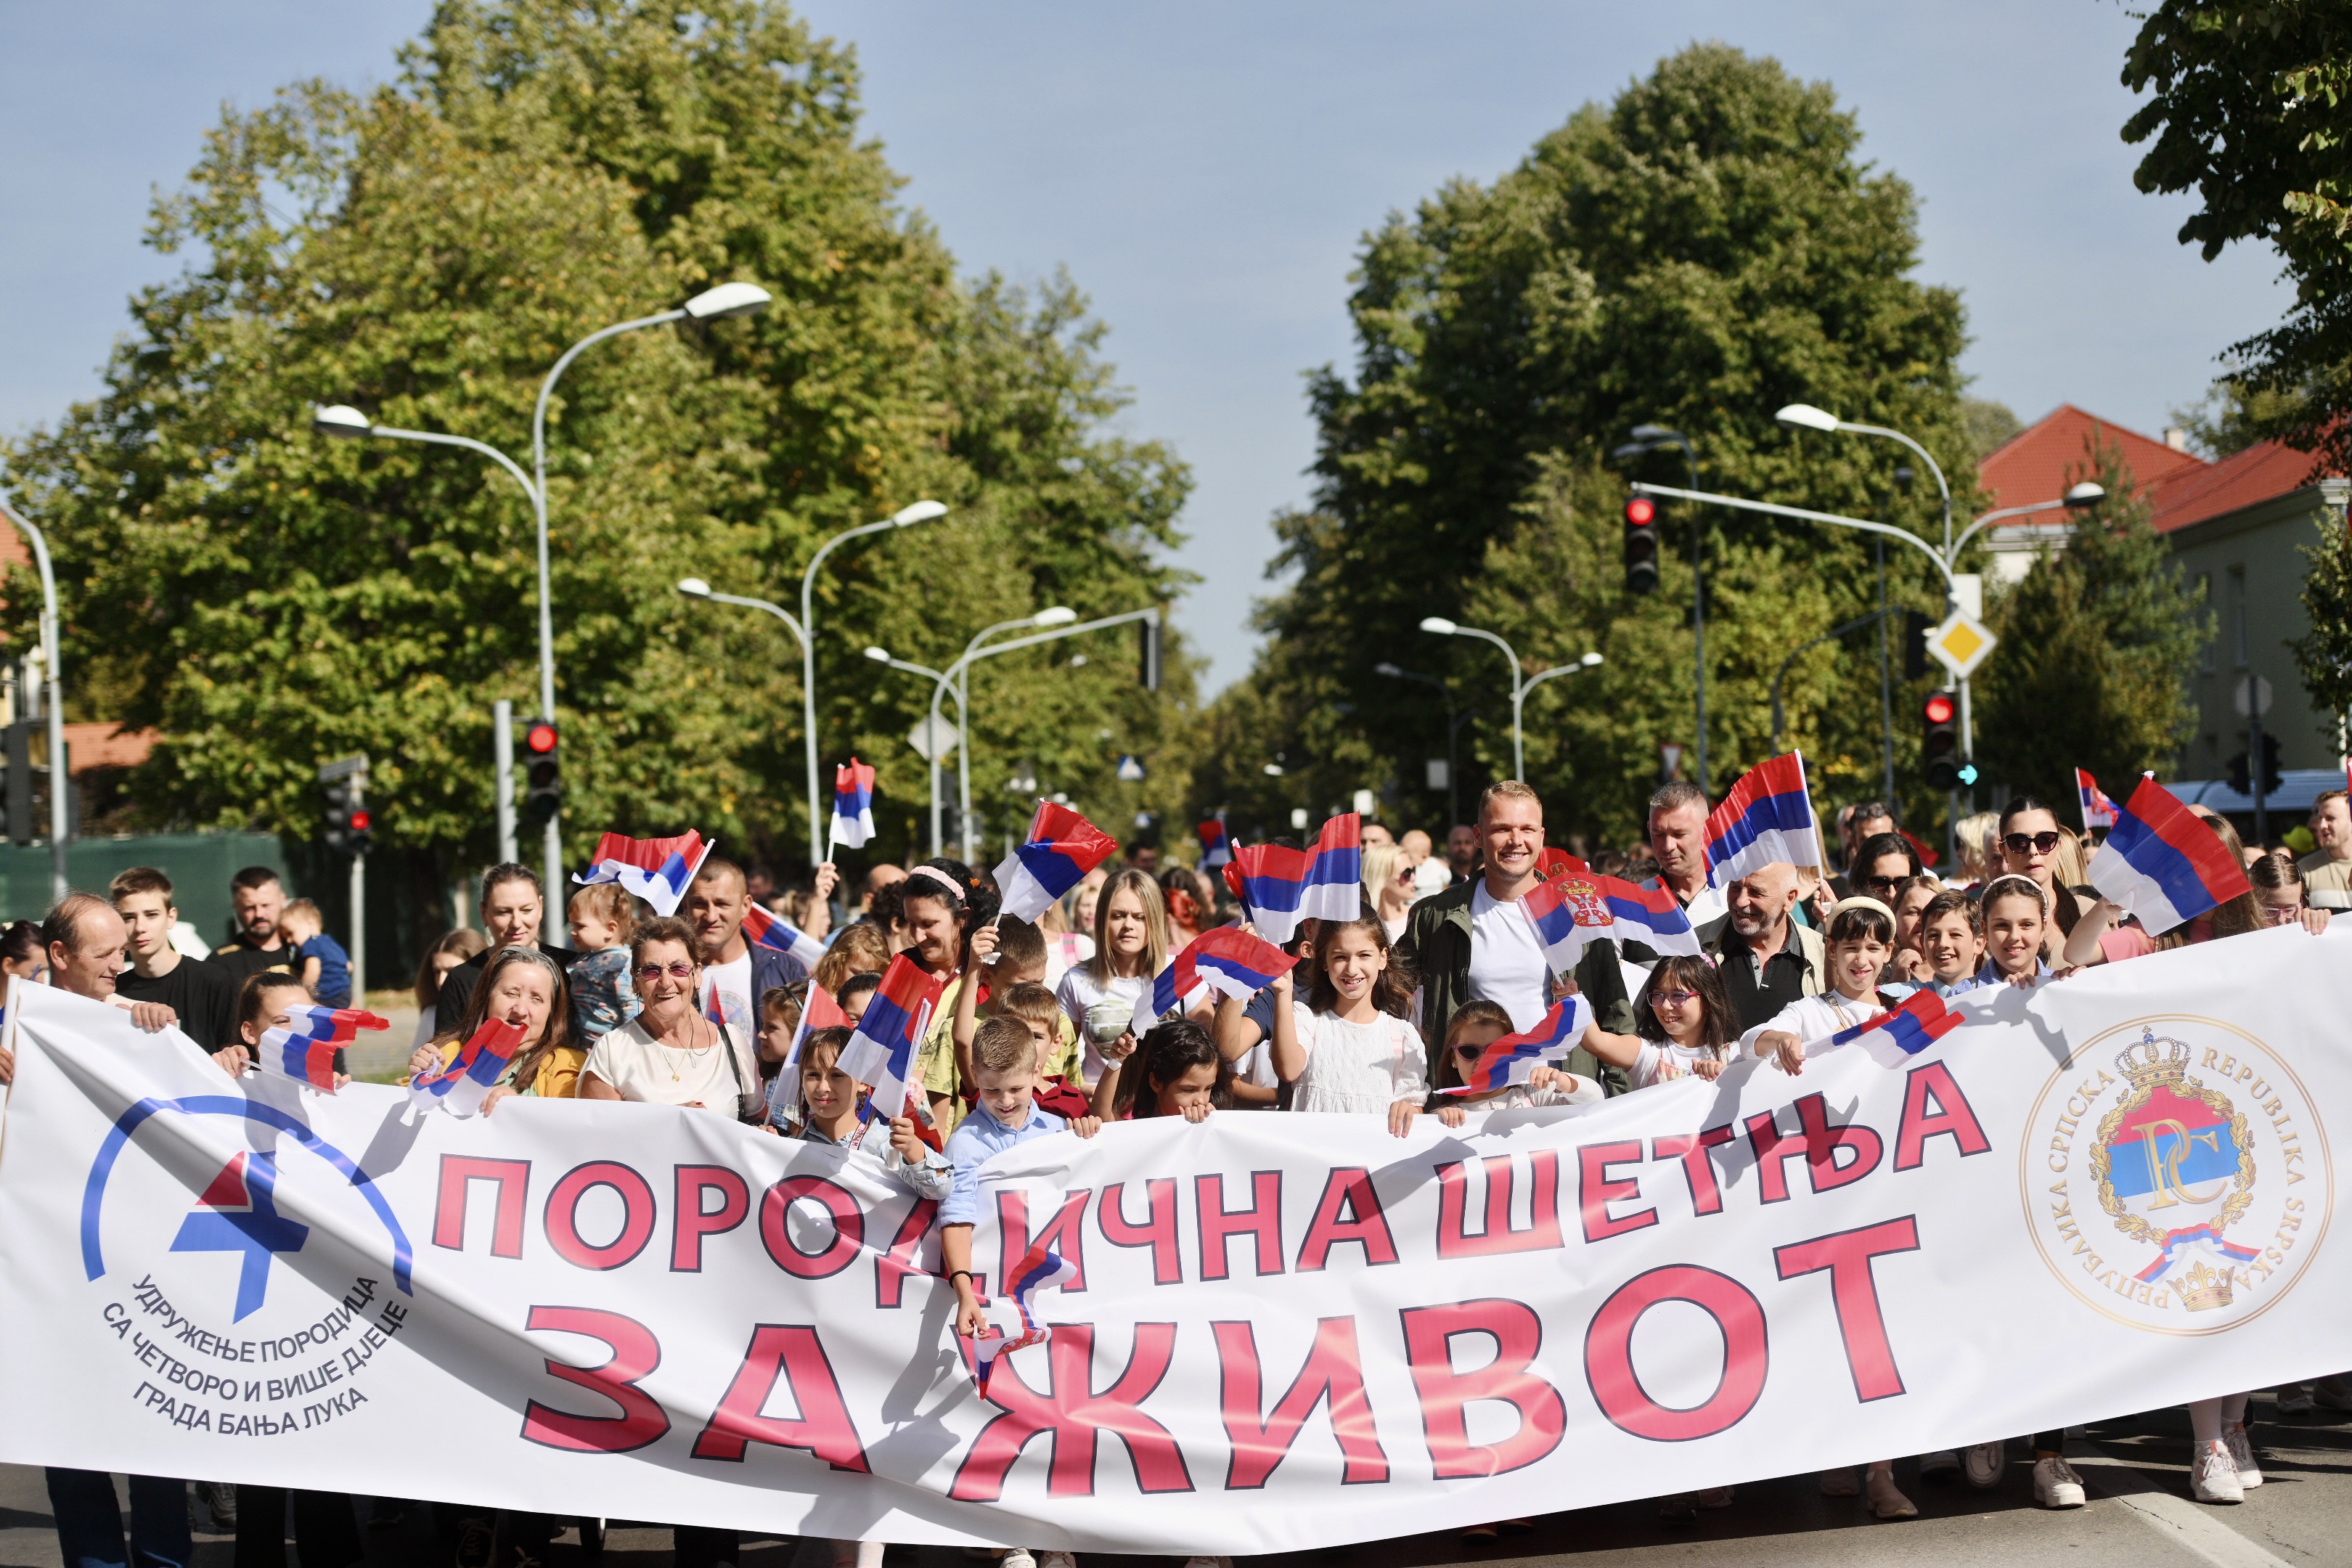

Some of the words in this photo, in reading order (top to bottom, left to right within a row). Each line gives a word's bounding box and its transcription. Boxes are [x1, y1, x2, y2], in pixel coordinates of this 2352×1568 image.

[1434, 1059, 1991, 1260] ШЕТЊА
[2049, 1069, 2115, 1172] СРПСКА
[2200, 1045, 2306, 1187] REPUBLIKA
[2049, 1179, 2172, 1309] РЕПУБЛИКА
[2232, 1197, 2306, 1291] SRPSKA
[103, 1302, 133, 1340] СА
[133, 1331, 238, 1400] ЧЕТВОРО
[244, 1381, 261, 1402] И
[266, 1359, 343, 1402] ВИШЕ
[341, 1300, 408, 1376] ДЈЕЦЕ
[132, 1273, 256, 1363] УДРУЖЕЊЕ
[261, 1277, 378, 1363] ПОРОДИЦА
[519, 1304, 872, 1474] ЗА
[947, 1213, 1921, 1503] ЖИВОТ
[133, 1381, 211, 1432] ГРАДА
[218, 1412, 299, 1437] БАЊА
[303, 1387, 369, 1429] ЛУКА
